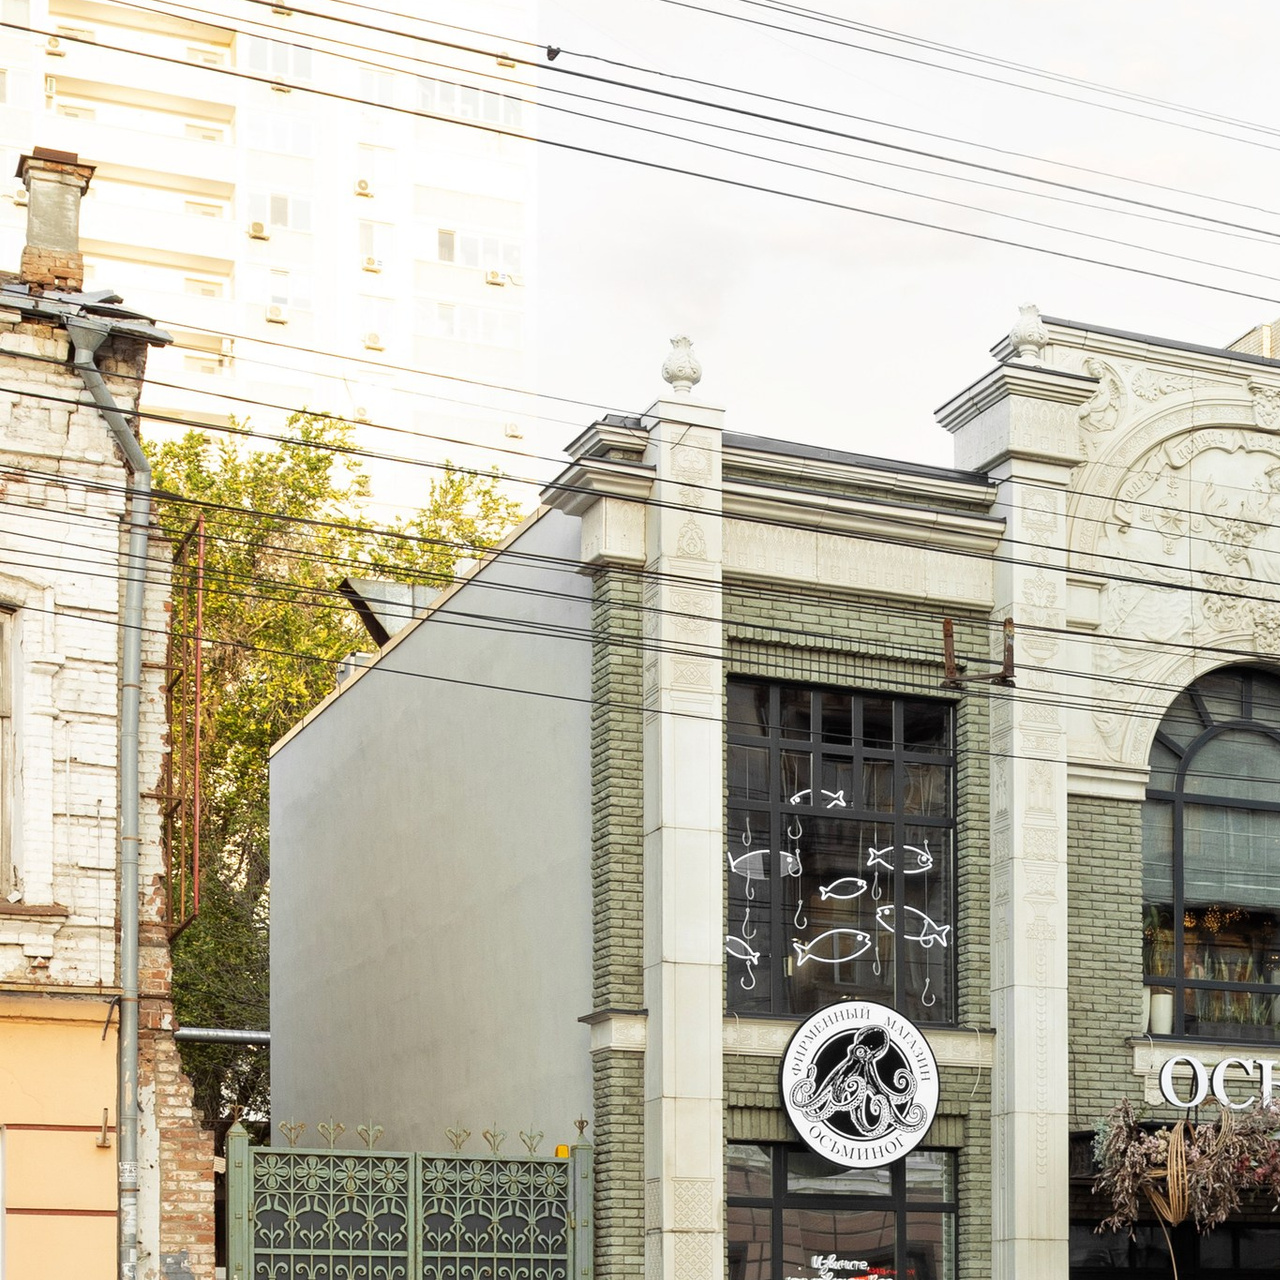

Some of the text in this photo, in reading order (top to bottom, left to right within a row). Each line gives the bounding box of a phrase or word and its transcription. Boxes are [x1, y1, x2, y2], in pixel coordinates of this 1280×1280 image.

[791, 1006, 931, 1082] ФИРМЕННЫЙ МАГАЗИН
[809, 1124, 906, 1161] ОСЬМИНОГ
[810, 1254, 870, 1275] Извините,
